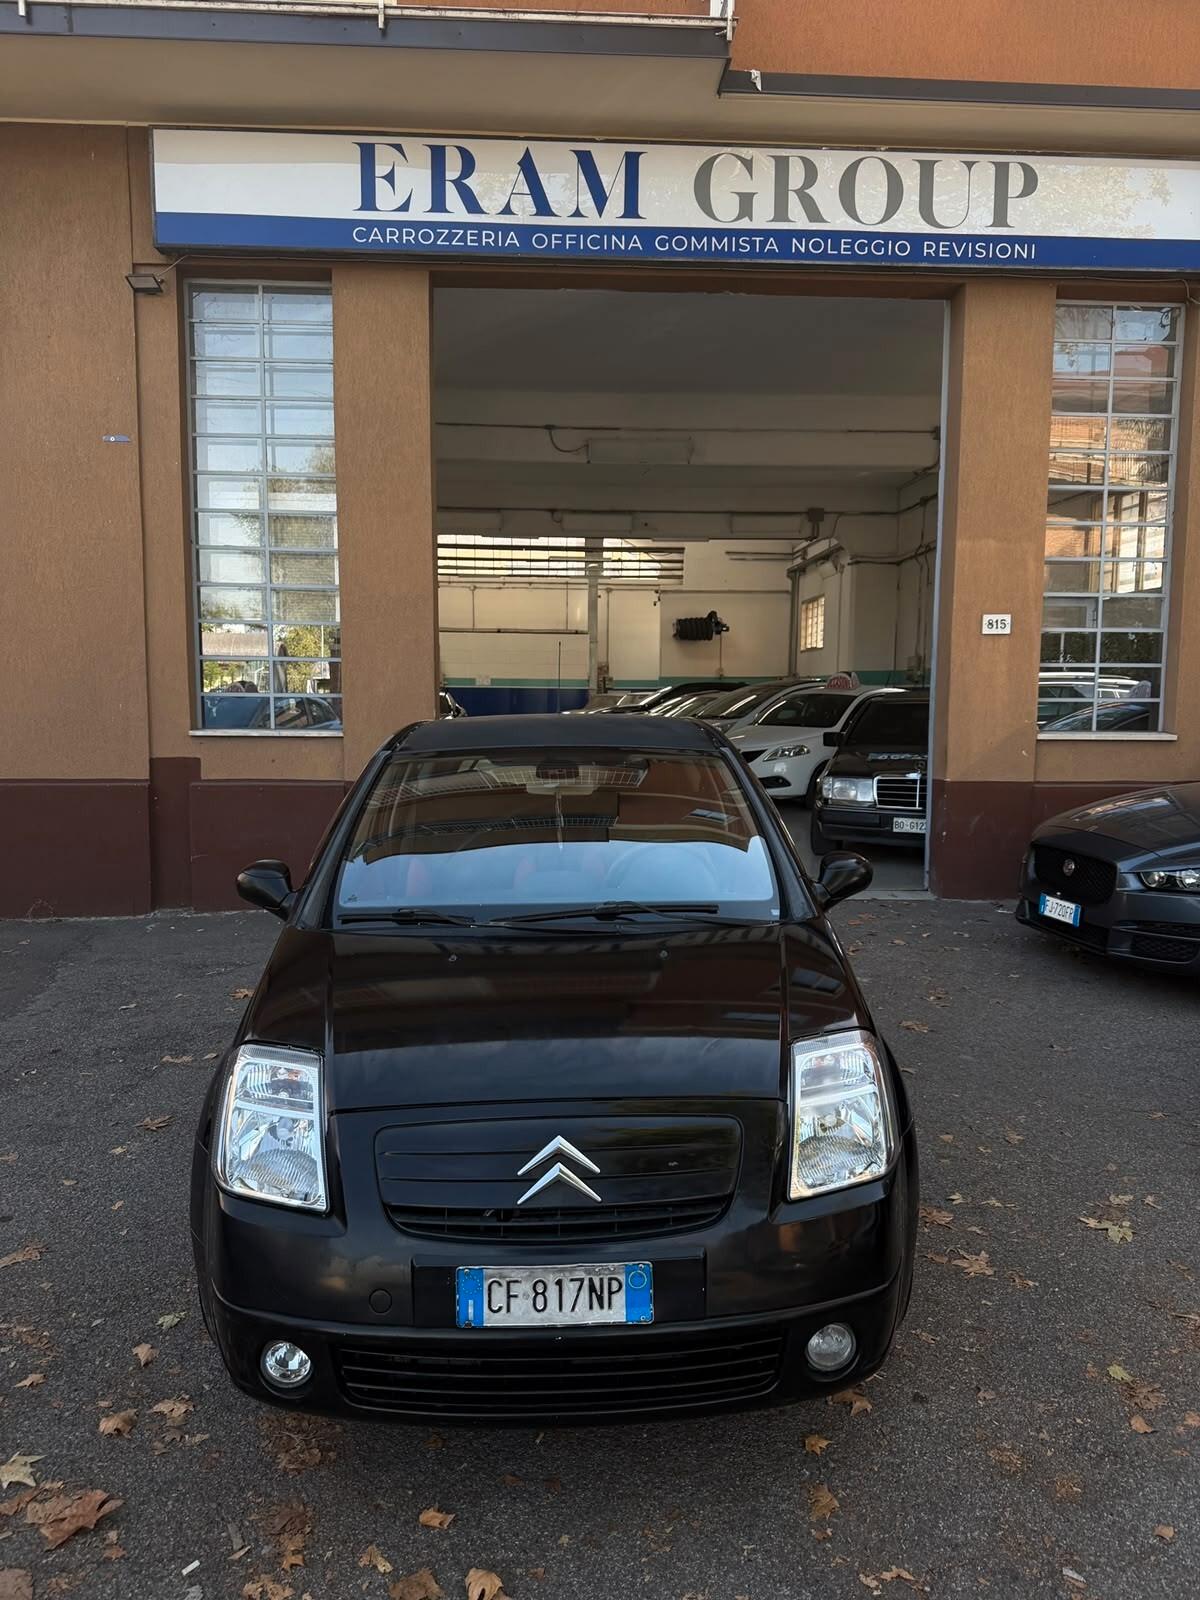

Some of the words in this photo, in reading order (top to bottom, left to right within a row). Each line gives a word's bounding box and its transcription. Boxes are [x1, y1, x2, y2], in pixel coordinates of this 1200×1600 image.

[352, 141, 648, 220] ERAM
[693, 151, 1039, 230] GROUP
[352, 226, 520, 248] CARROZZERIA
[531, 232, 643, 251] OFFICINA
[655, 234, 779, 254] GOMMISTA
[791, 238, 911, 258] NOLEGGIO
[923, 240, 1036, 260] REVISIONI
[987, 618, 1007, 630] 815
